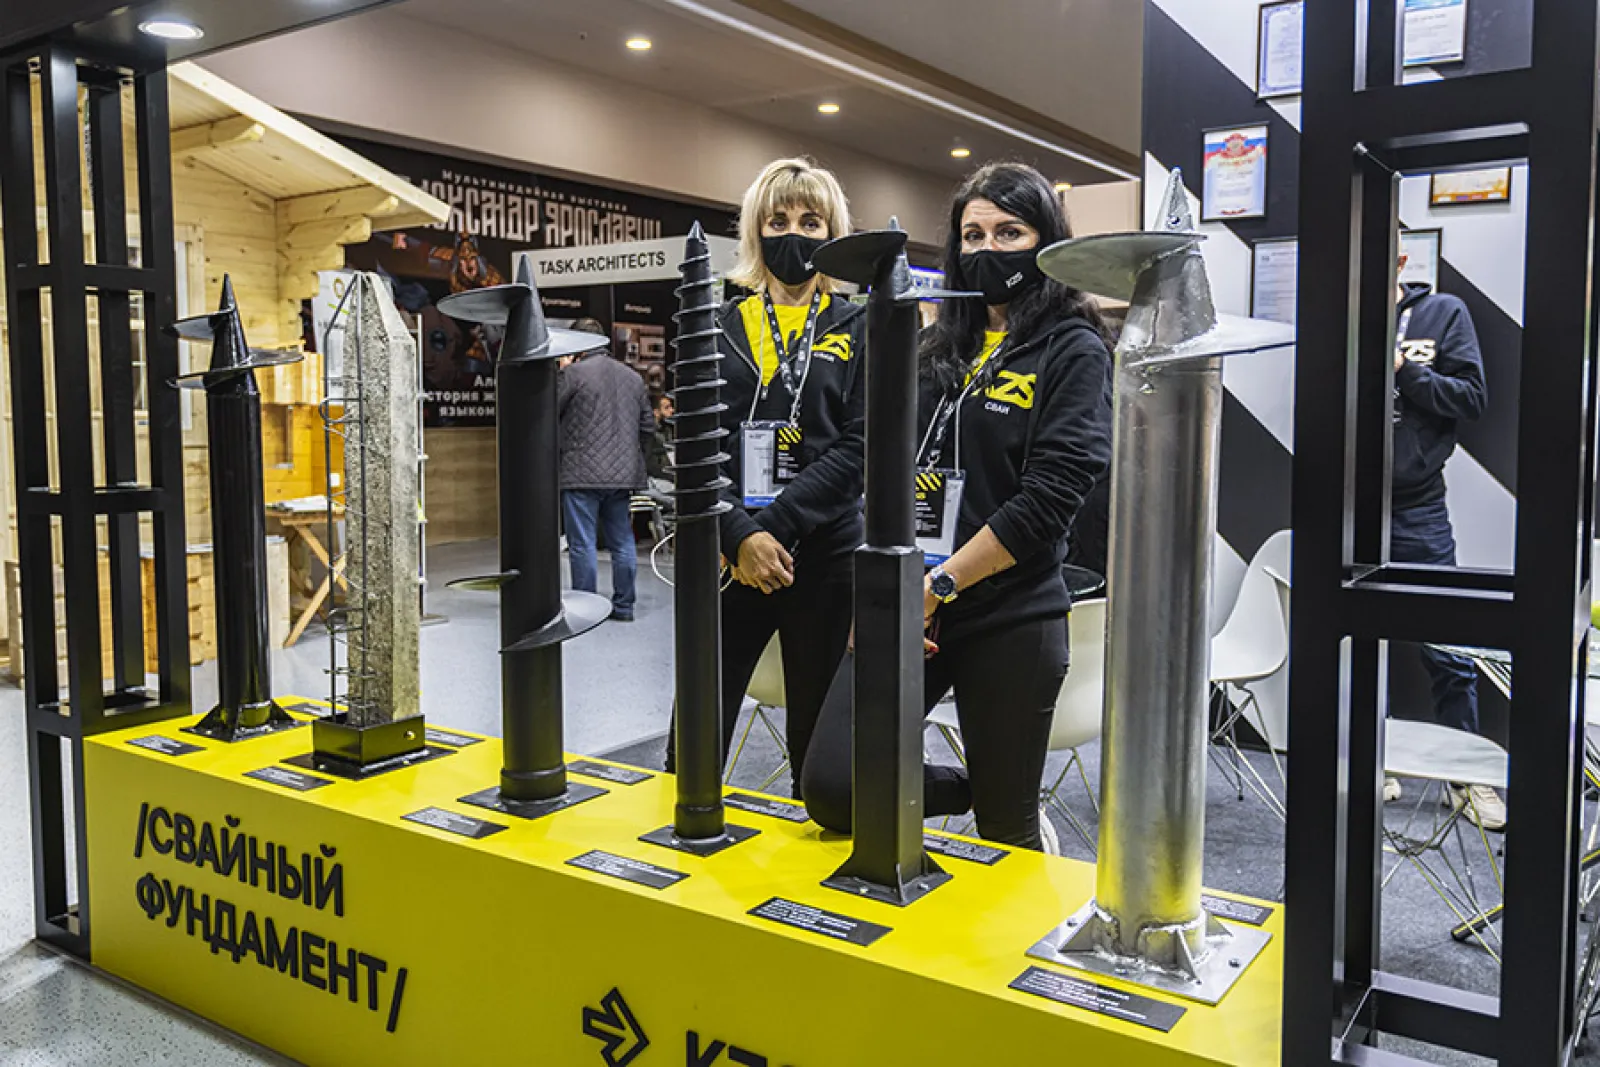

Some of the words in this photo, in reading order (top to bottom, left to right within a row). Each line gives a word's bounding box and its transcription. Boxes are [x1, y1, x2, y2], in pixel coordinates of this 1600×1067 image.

[539, 259, 574, 275] TASK
[576, 250, 666, 273] ARCHITECTS
[427, 390, 479, 405] стория
